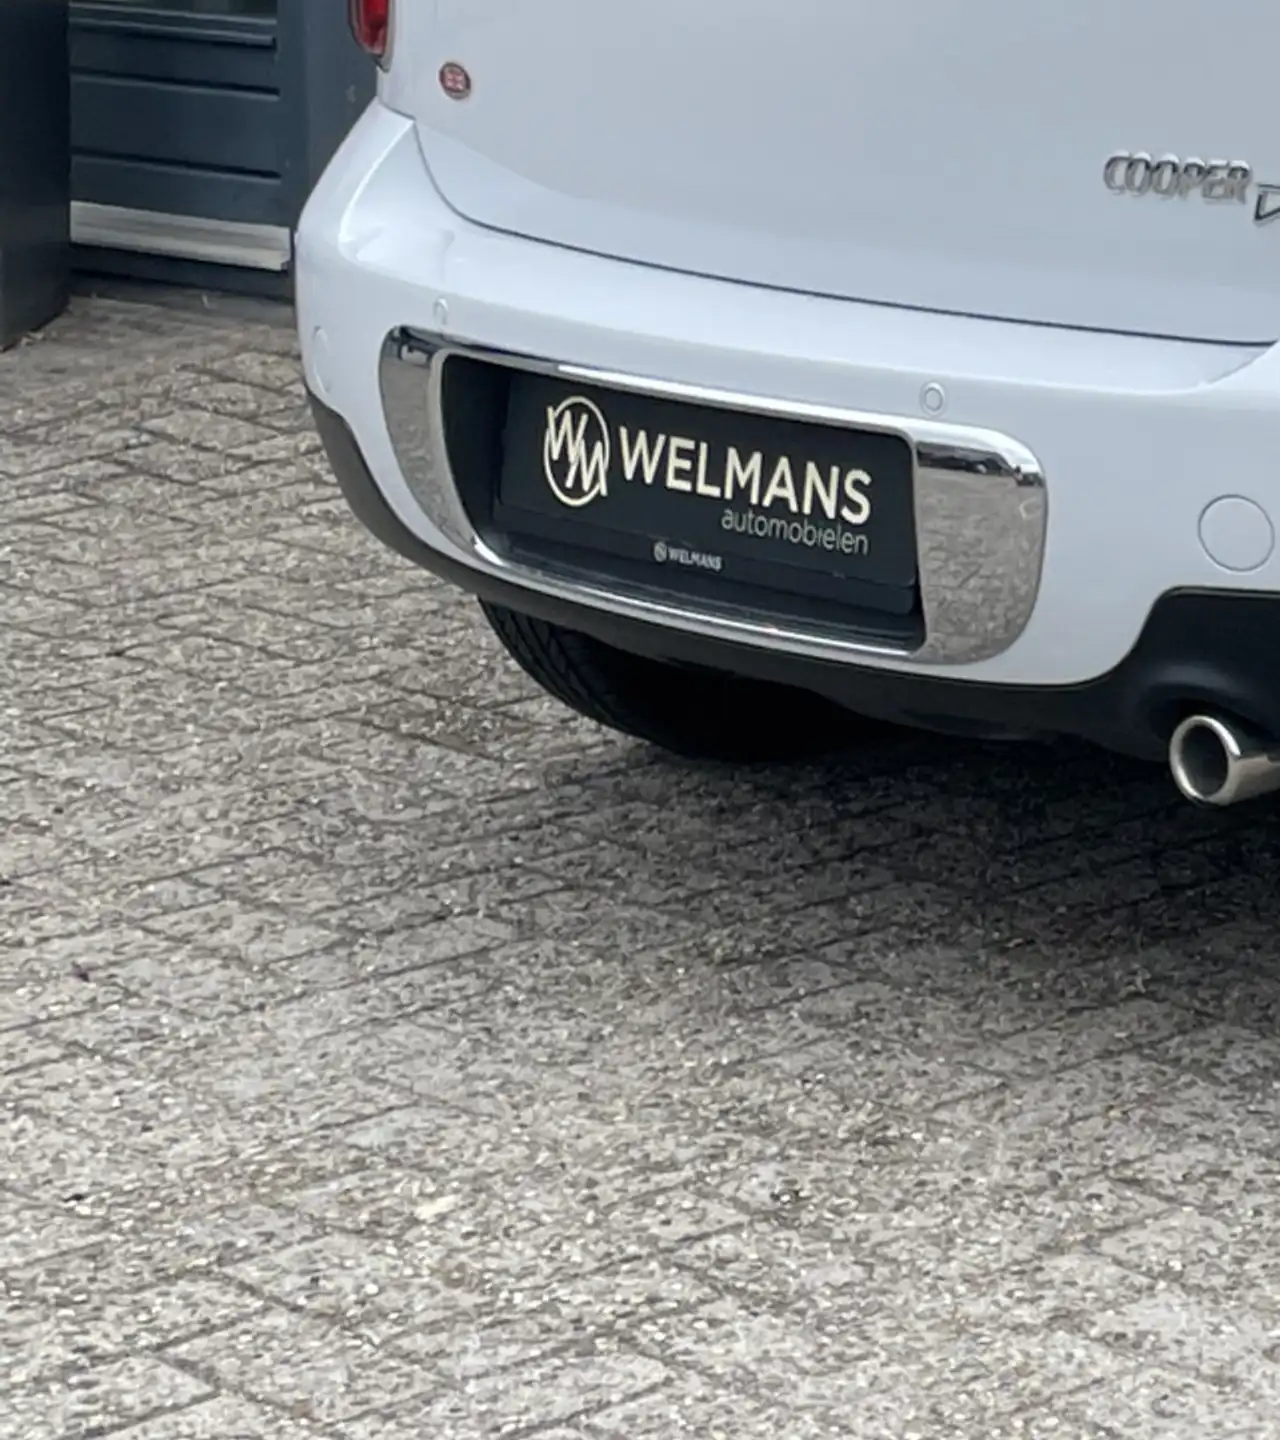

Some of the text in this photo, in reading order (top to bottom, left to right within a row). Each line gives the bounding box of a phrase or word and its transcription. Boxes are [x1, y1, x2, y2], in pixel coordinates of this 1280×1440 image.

[1102, 149, 1252, 206] COOPER
[618, 424, 873, 526] WELMANS
[720, 507, 869, 557] automobielen
